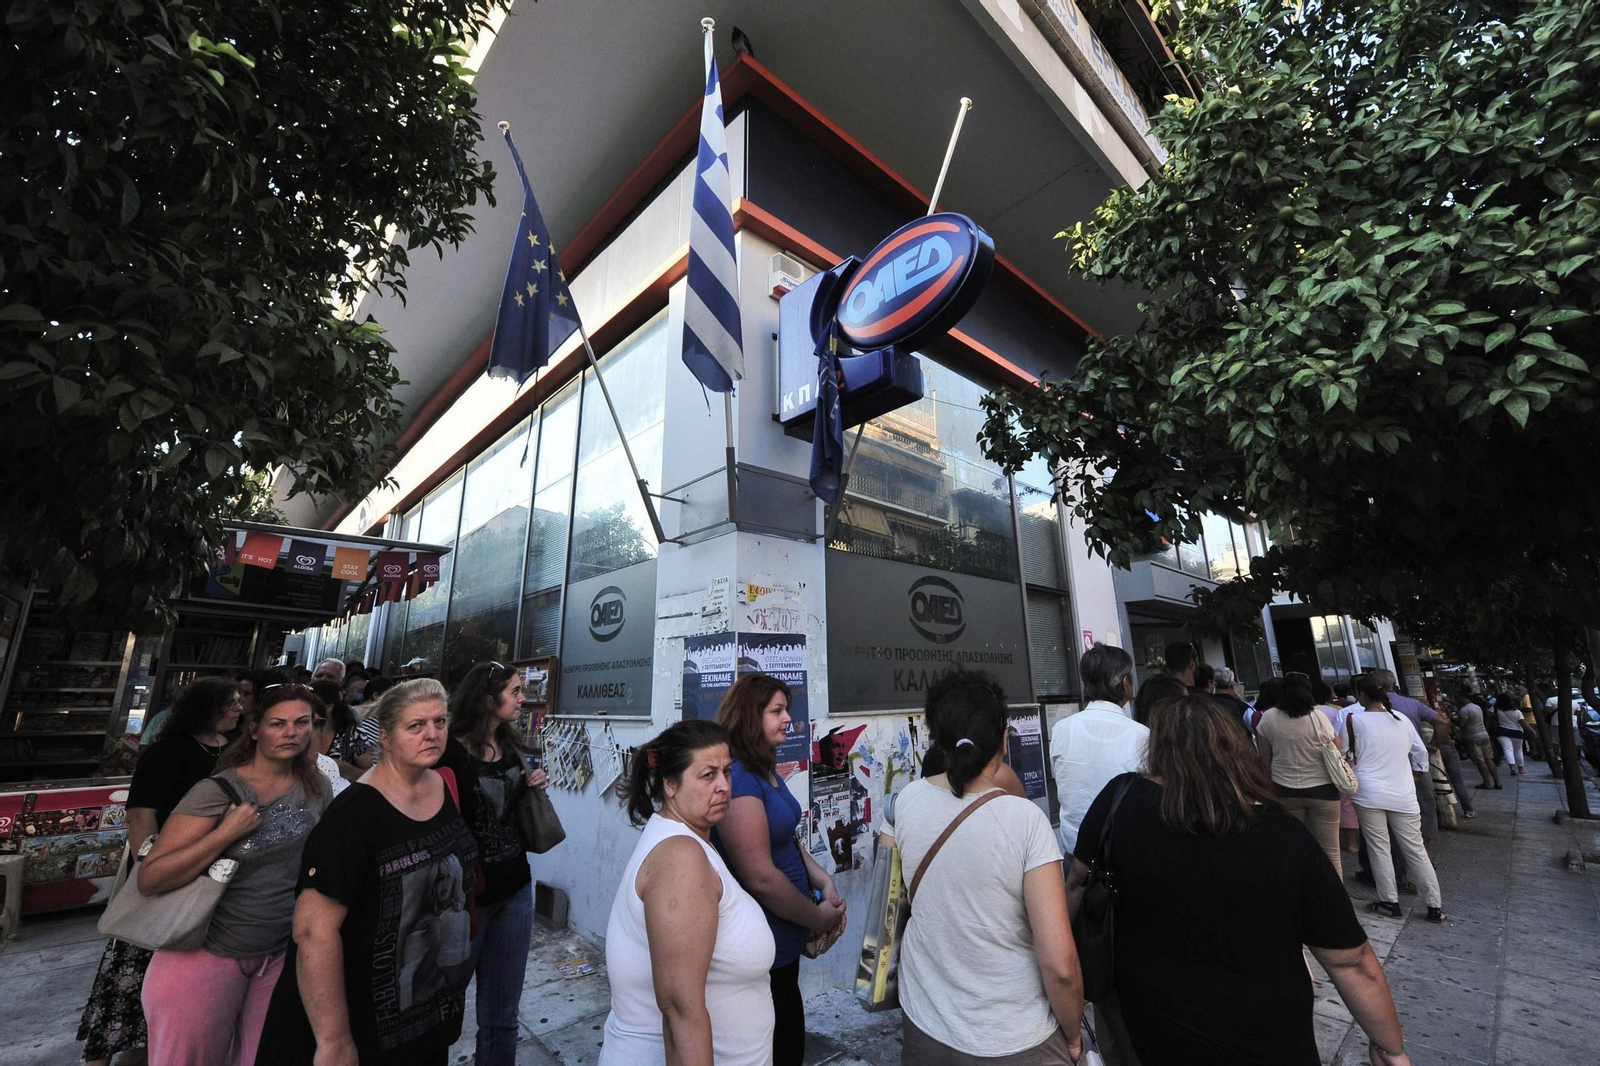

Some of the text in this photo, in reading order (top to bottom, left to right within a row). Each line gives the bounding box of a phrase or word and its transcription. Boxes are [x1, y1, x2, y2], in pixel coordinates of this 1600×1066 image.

[783, 379, 820, 413] ΚΠ
[258, 556, 273, 564] HOT
[293, 564, 314, 572] ALGIDA
[701, 656, 732, 664] ΘΕΣΣΑΛΟΝΙΚΗ
[895, 647, 954, 662] ΠΡΟΩΘΗΣΗΣ
[956, 650, 1014, 664] ΑΠΑΣΧΟΛΗΣΗΣ
[704, 662, 731, 670] ΣΕΠΤΕΜΒΡΙΟΥ
[701, 673, 732, 683] ΞΕΚΙΝΑΜΕ
[577, 683, 625, 699] ΚΑΛΛΙΘΕΑΣ
[378, 850, 431, 877] FABULOUS
[372, 931, 399, 1023] FABULOUS
